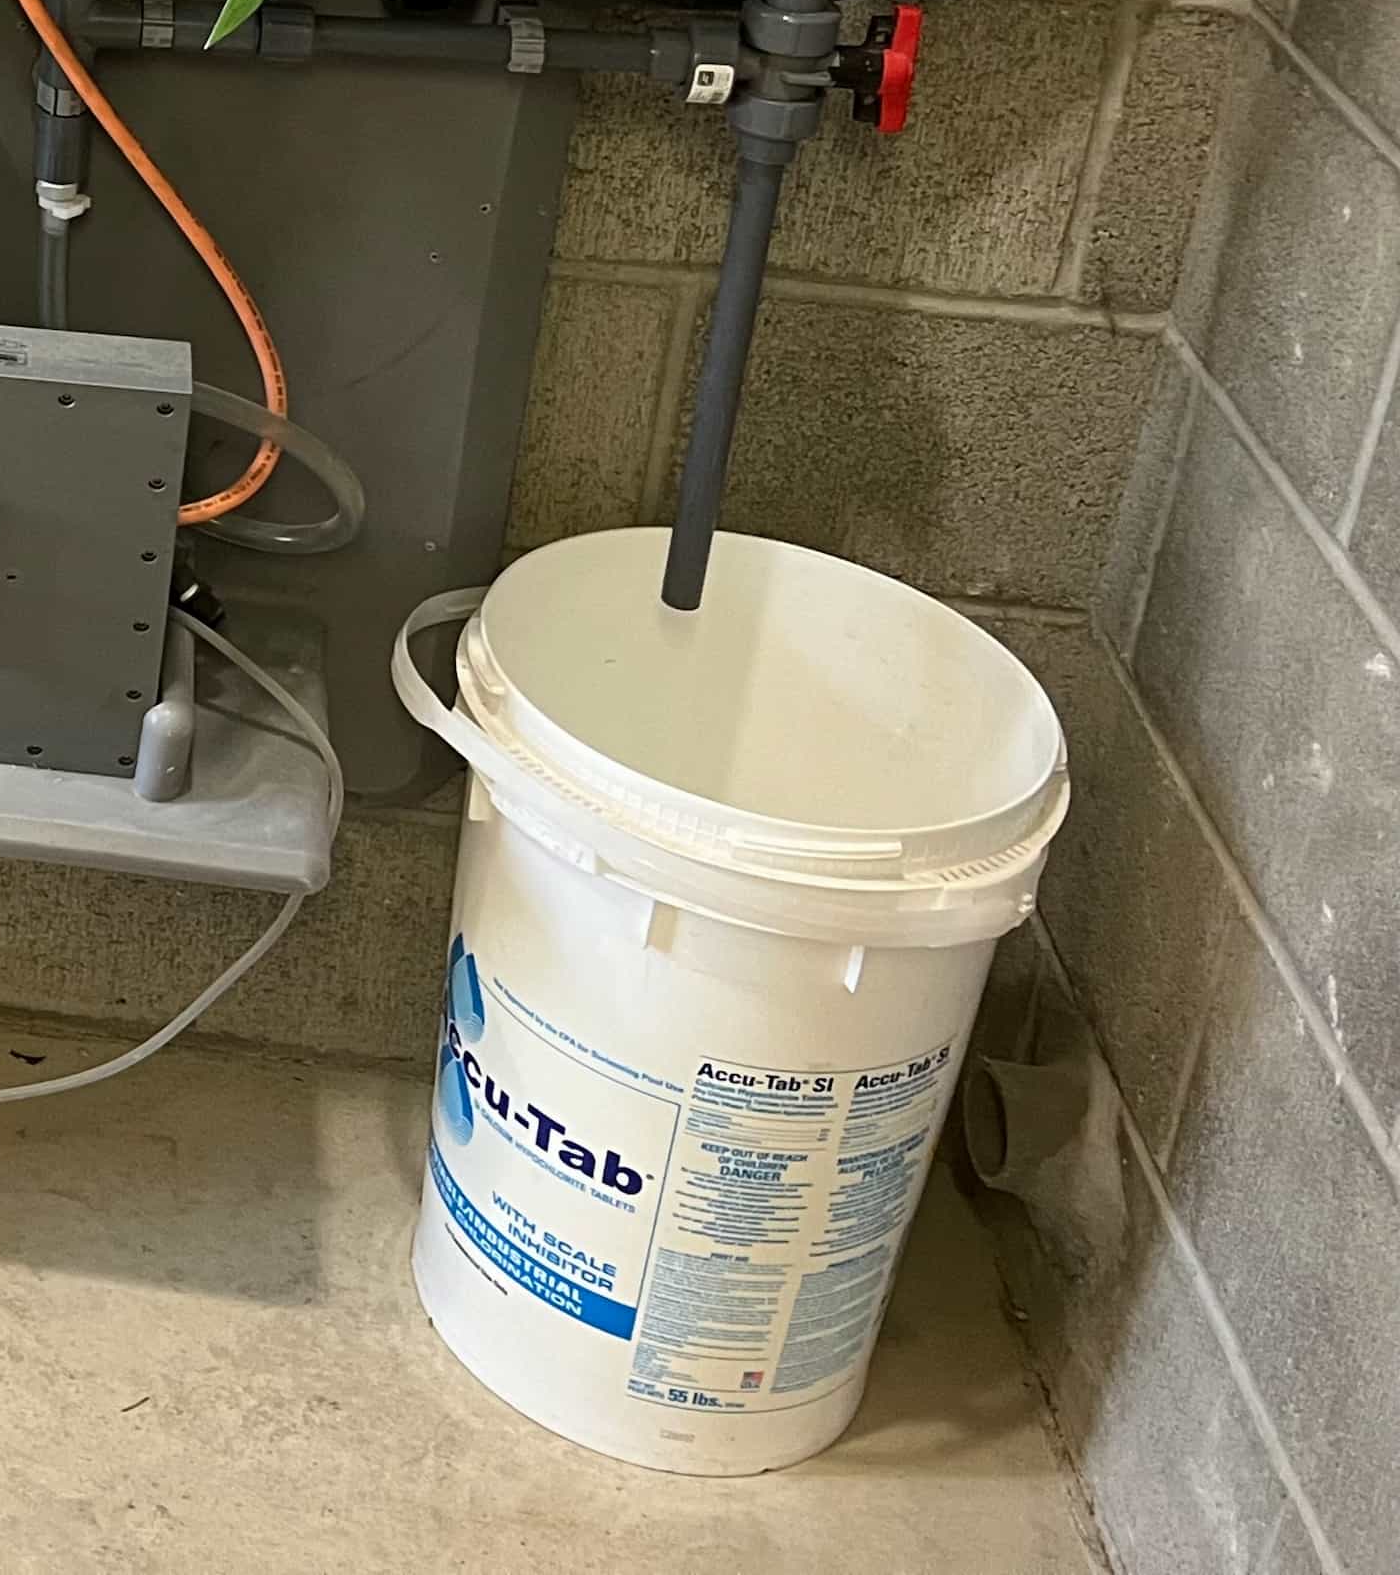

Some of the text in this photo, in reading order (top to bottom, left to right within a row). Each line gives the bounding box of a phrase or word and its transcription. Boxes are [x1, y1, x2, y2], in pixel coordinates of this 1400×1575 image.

[812, 1077, 835, 1093] SI
[731, 1149, 754, 1158] OUT
[720, 1166, 781, 1182] DANGER
[590, 1185, 636, 1214] TABLETS
[491, 1190, 536, 1234] WITH
[543, 1231, 617, 1278] SCALE
[508, 1223, 614, 1292] INHIBITOR
[667, 1388, 688, 1403] 55
